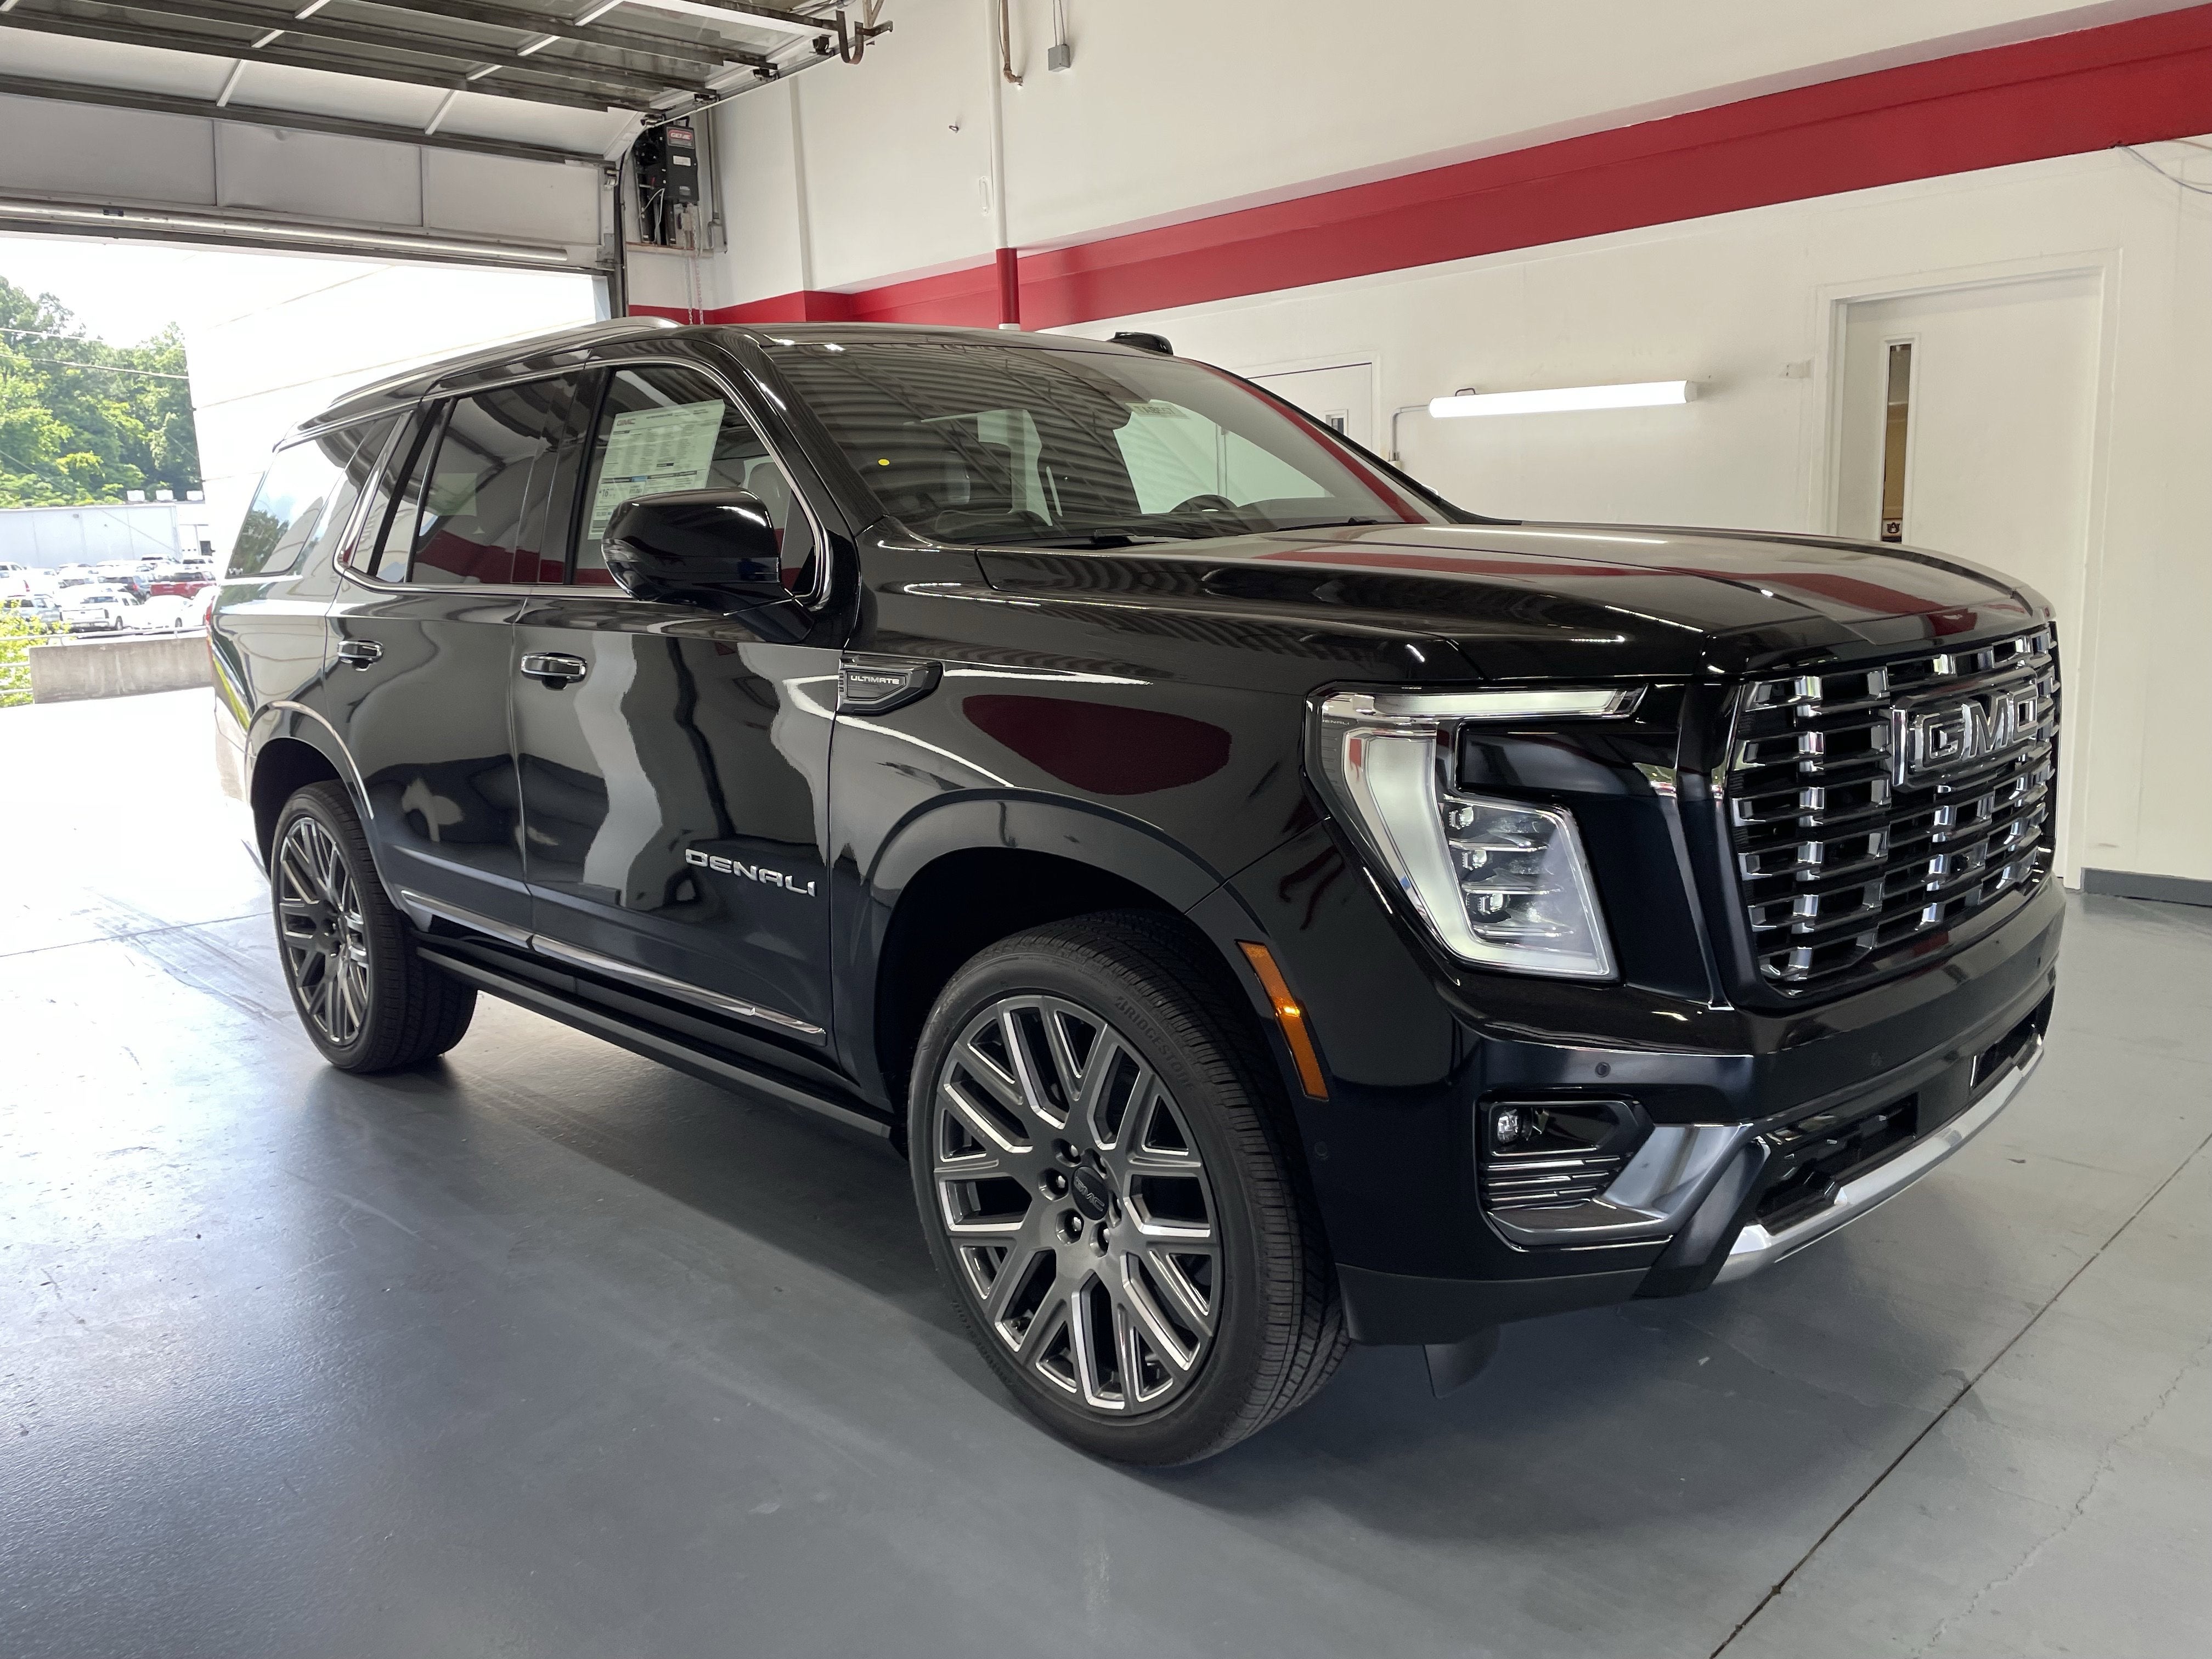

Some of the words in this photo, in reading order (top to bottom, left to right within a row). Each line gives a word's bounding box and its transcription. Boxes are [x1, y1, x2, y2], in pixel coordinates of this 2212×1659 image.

[850, 675, 900, 685] ULTIMATE
[1914, 684, 2039, 770] GMC
[685, 848, 817, 897] DENALI
[1074, 1176, 1105, 1212] GMC
